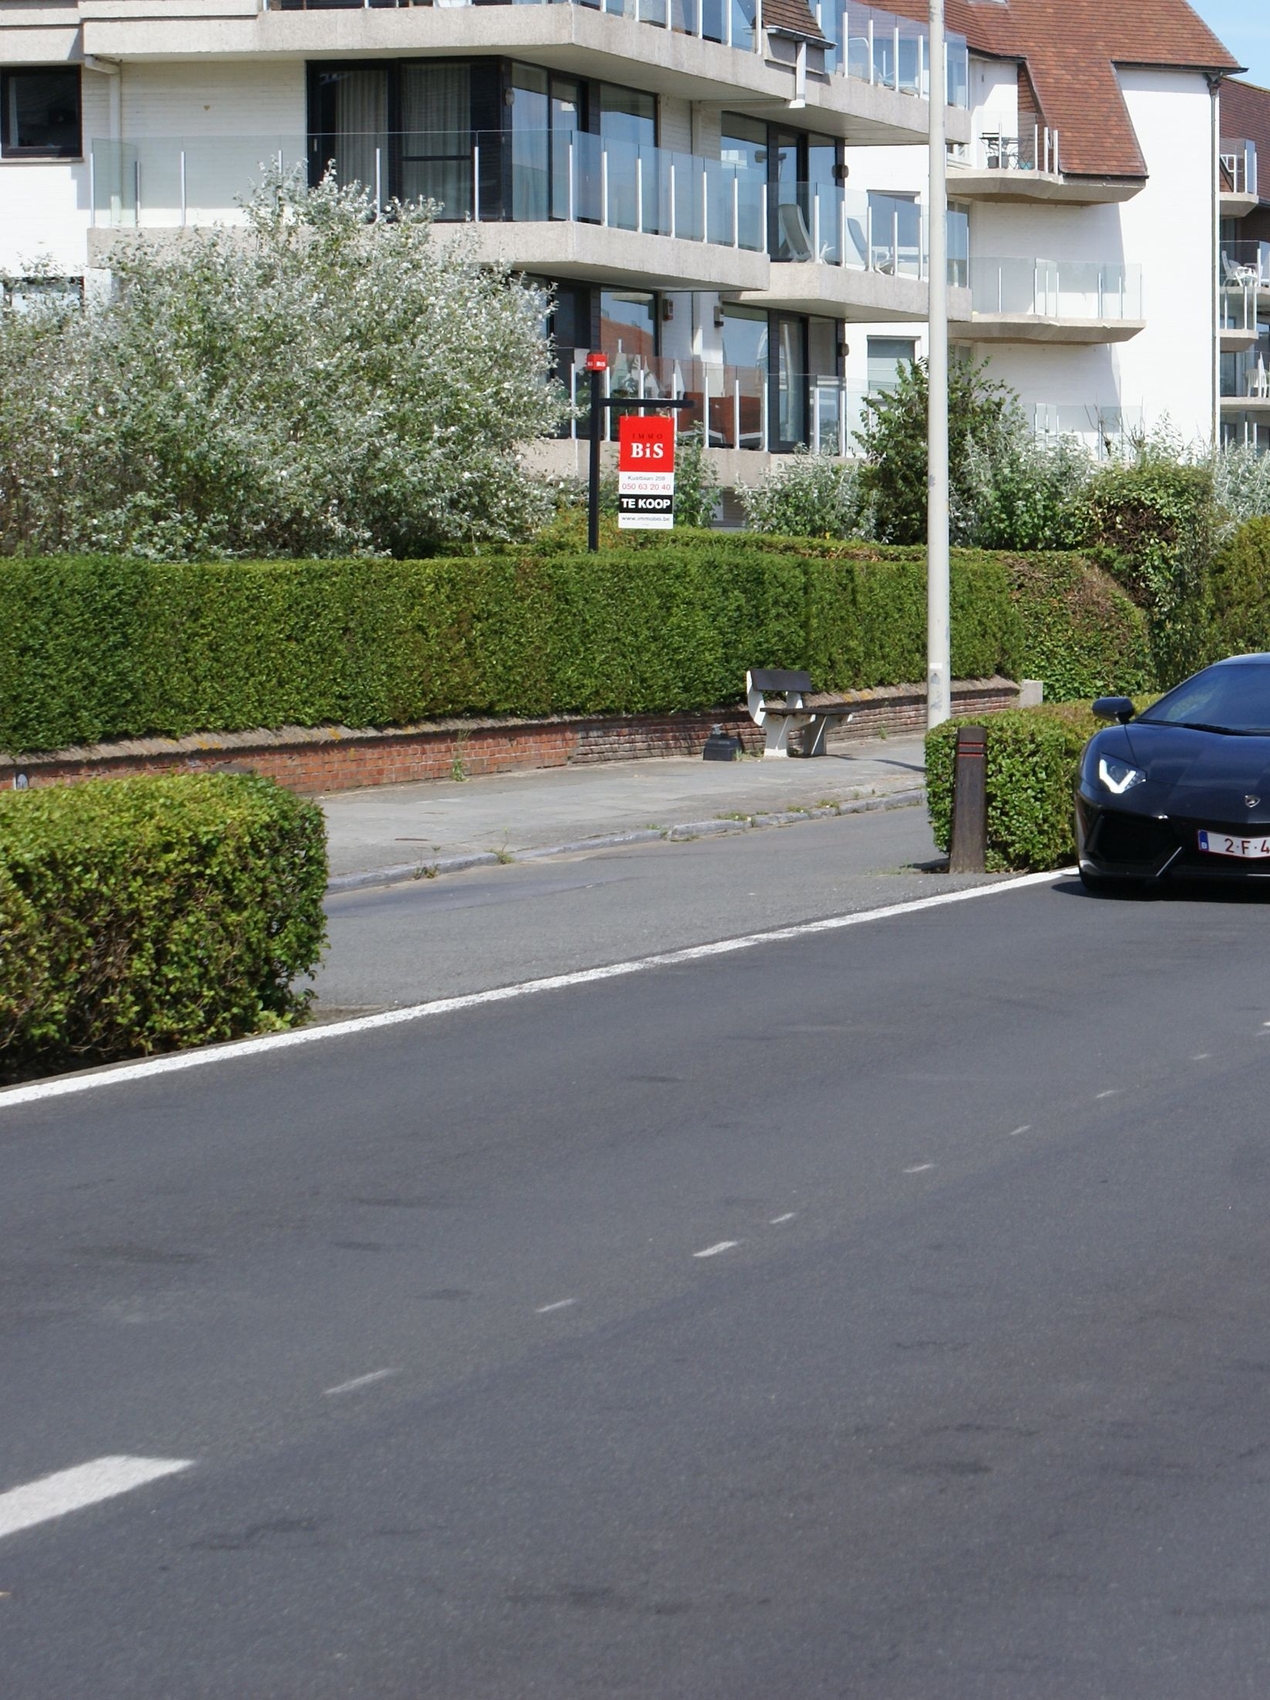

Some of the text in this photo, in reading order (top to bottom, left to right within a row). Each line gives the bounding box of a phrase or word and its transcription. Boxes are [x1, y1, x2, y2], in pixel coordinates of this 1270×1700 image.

[621, 482, 636, 490] 050
[638, 483, 648, 491] 63
[649, 483, 660, 491] 20
[621, 498, 671, 509] TE KOOP
